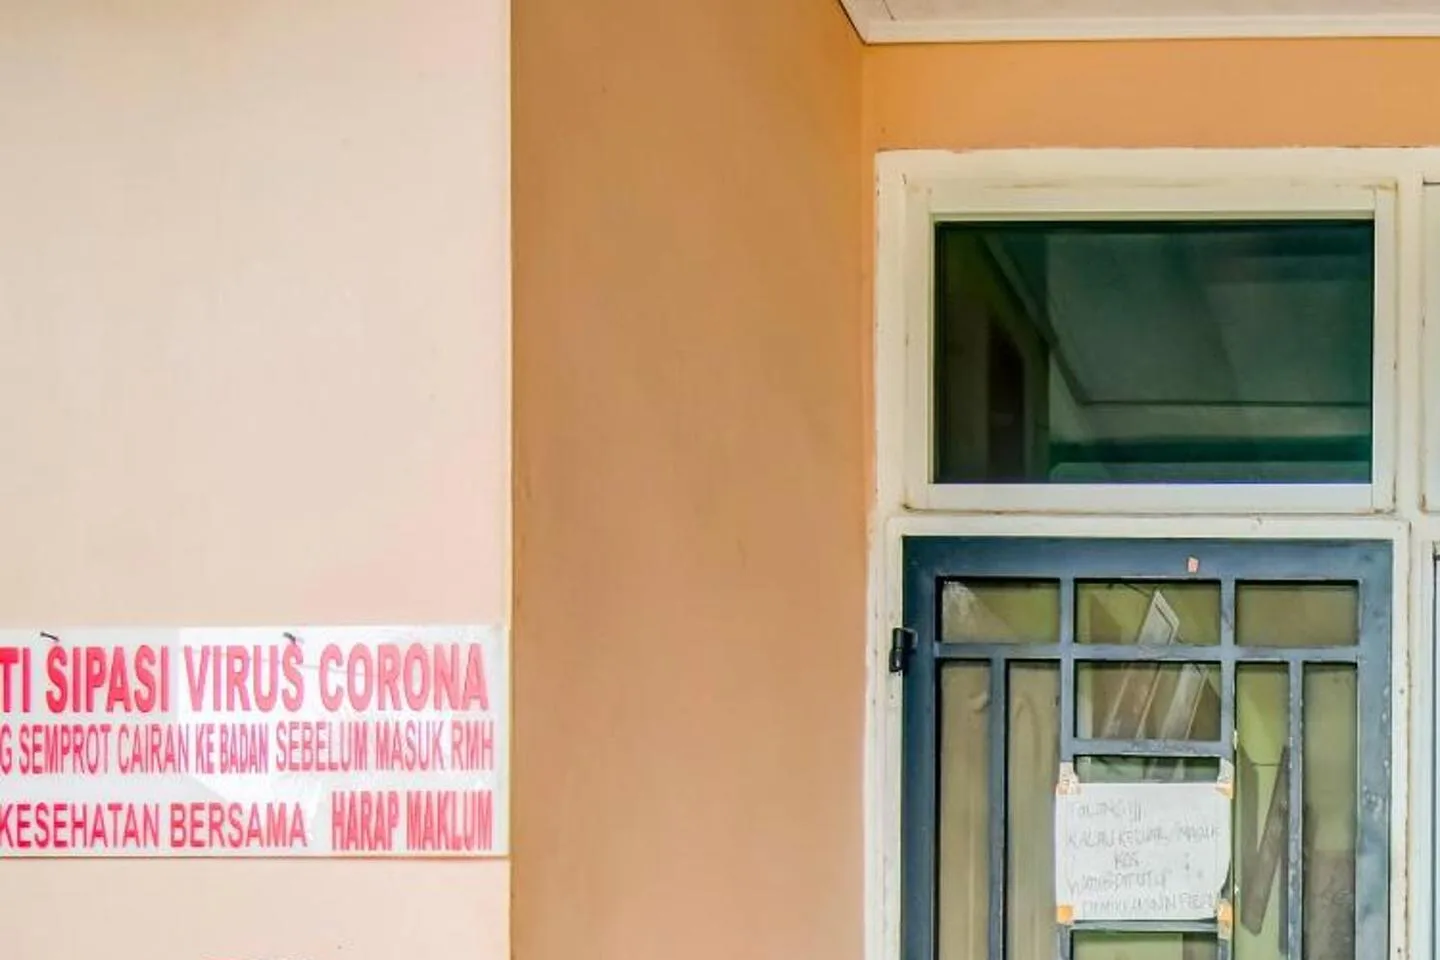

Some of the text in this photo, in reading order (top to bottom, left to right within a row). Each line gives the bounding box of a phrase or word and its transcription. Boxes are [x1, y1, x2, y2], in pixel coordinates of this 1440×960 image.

[45, 645, 170, 713] SIPASI
[184, 644, 305, 713] VIRUS
[318, 643, 490, 712] CORONA
[18, 723, 113, 775] SEMPROT
[118, 723, 190, 774] CAIRAN
[195, 722, 215, 774] KE
[220, 722, 269, 774] BADAN
[275, 721, 369, 772] SEBELUM
[375, 720, 445, 772] MASUK
[0, 790, 493, 851] KESEHATAN BERSAMA HARAP MAKLUM
